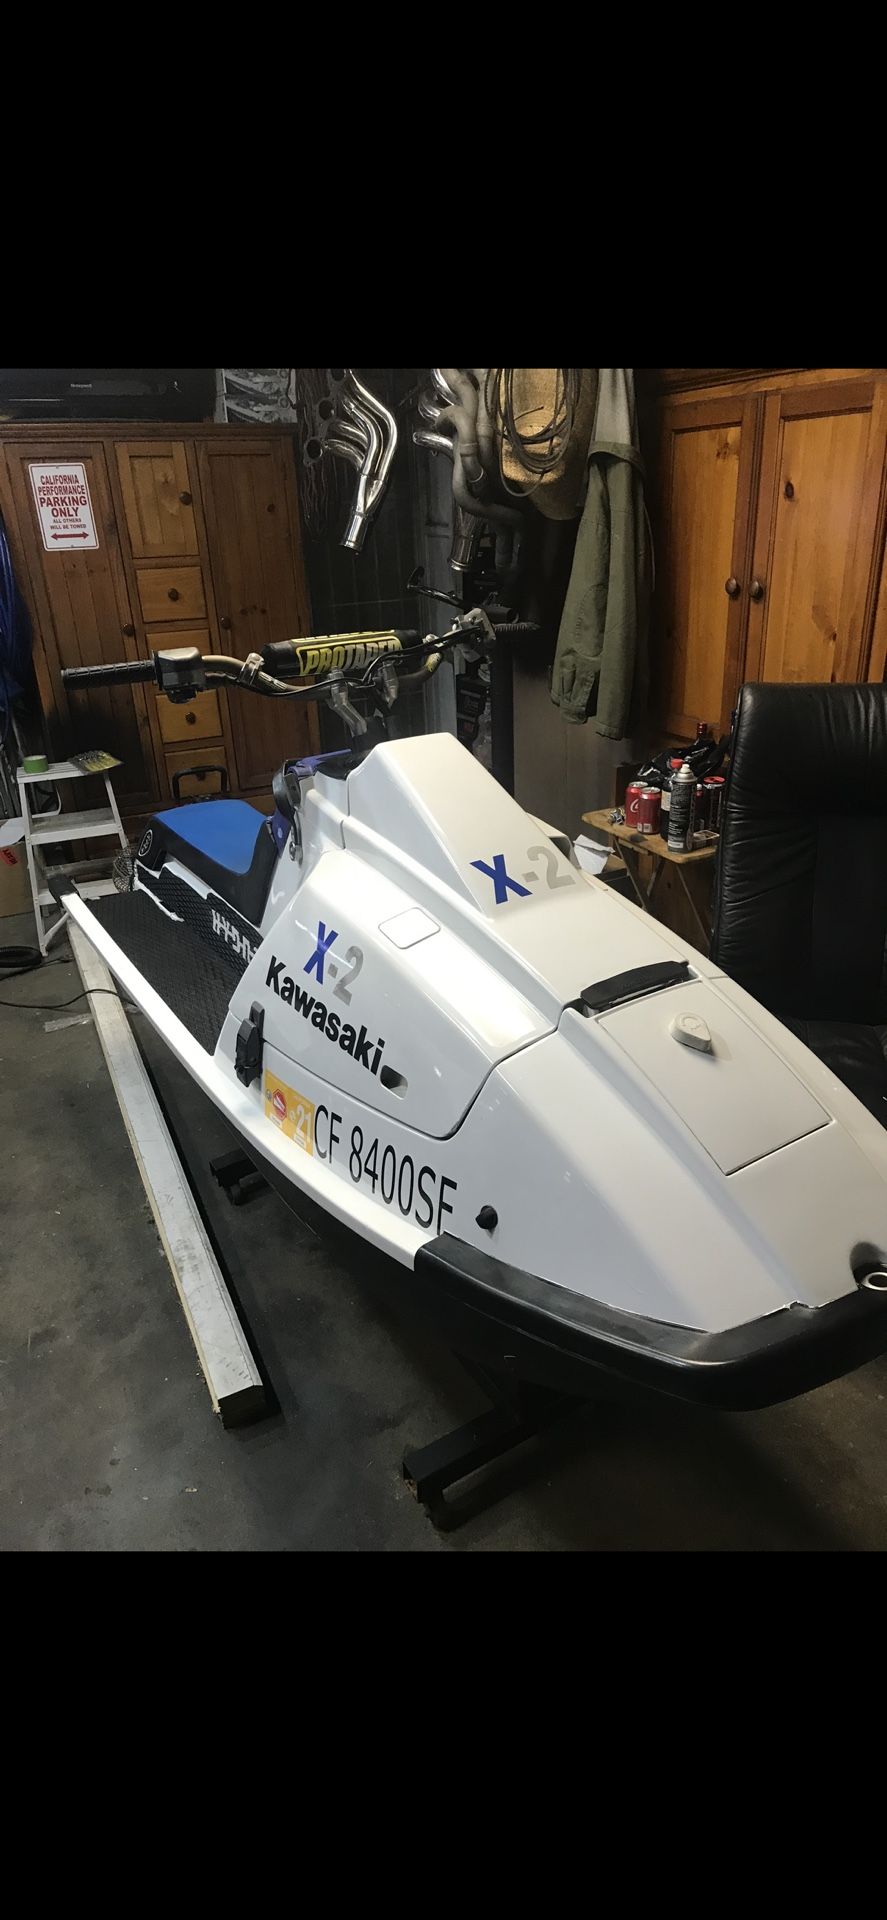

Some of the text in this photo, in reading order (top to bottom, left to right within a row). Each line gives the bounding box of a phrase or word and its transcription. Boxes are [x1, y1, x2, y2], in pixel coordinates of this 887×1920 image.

[38, 485, 86, 496] PERFORMANCE
[40, 474, 80, 485] CALIFORNIA
[39, 496, 87, 507] PARKING
[51, 507, 79, 518] ONLY
[469, 846, 576, 905] X-2
[303, 921, 364, 1006] X-2
[265, 955, 386, 1076] Kawasaki
[315, 1104, 458, 1236] CF 8400SF
